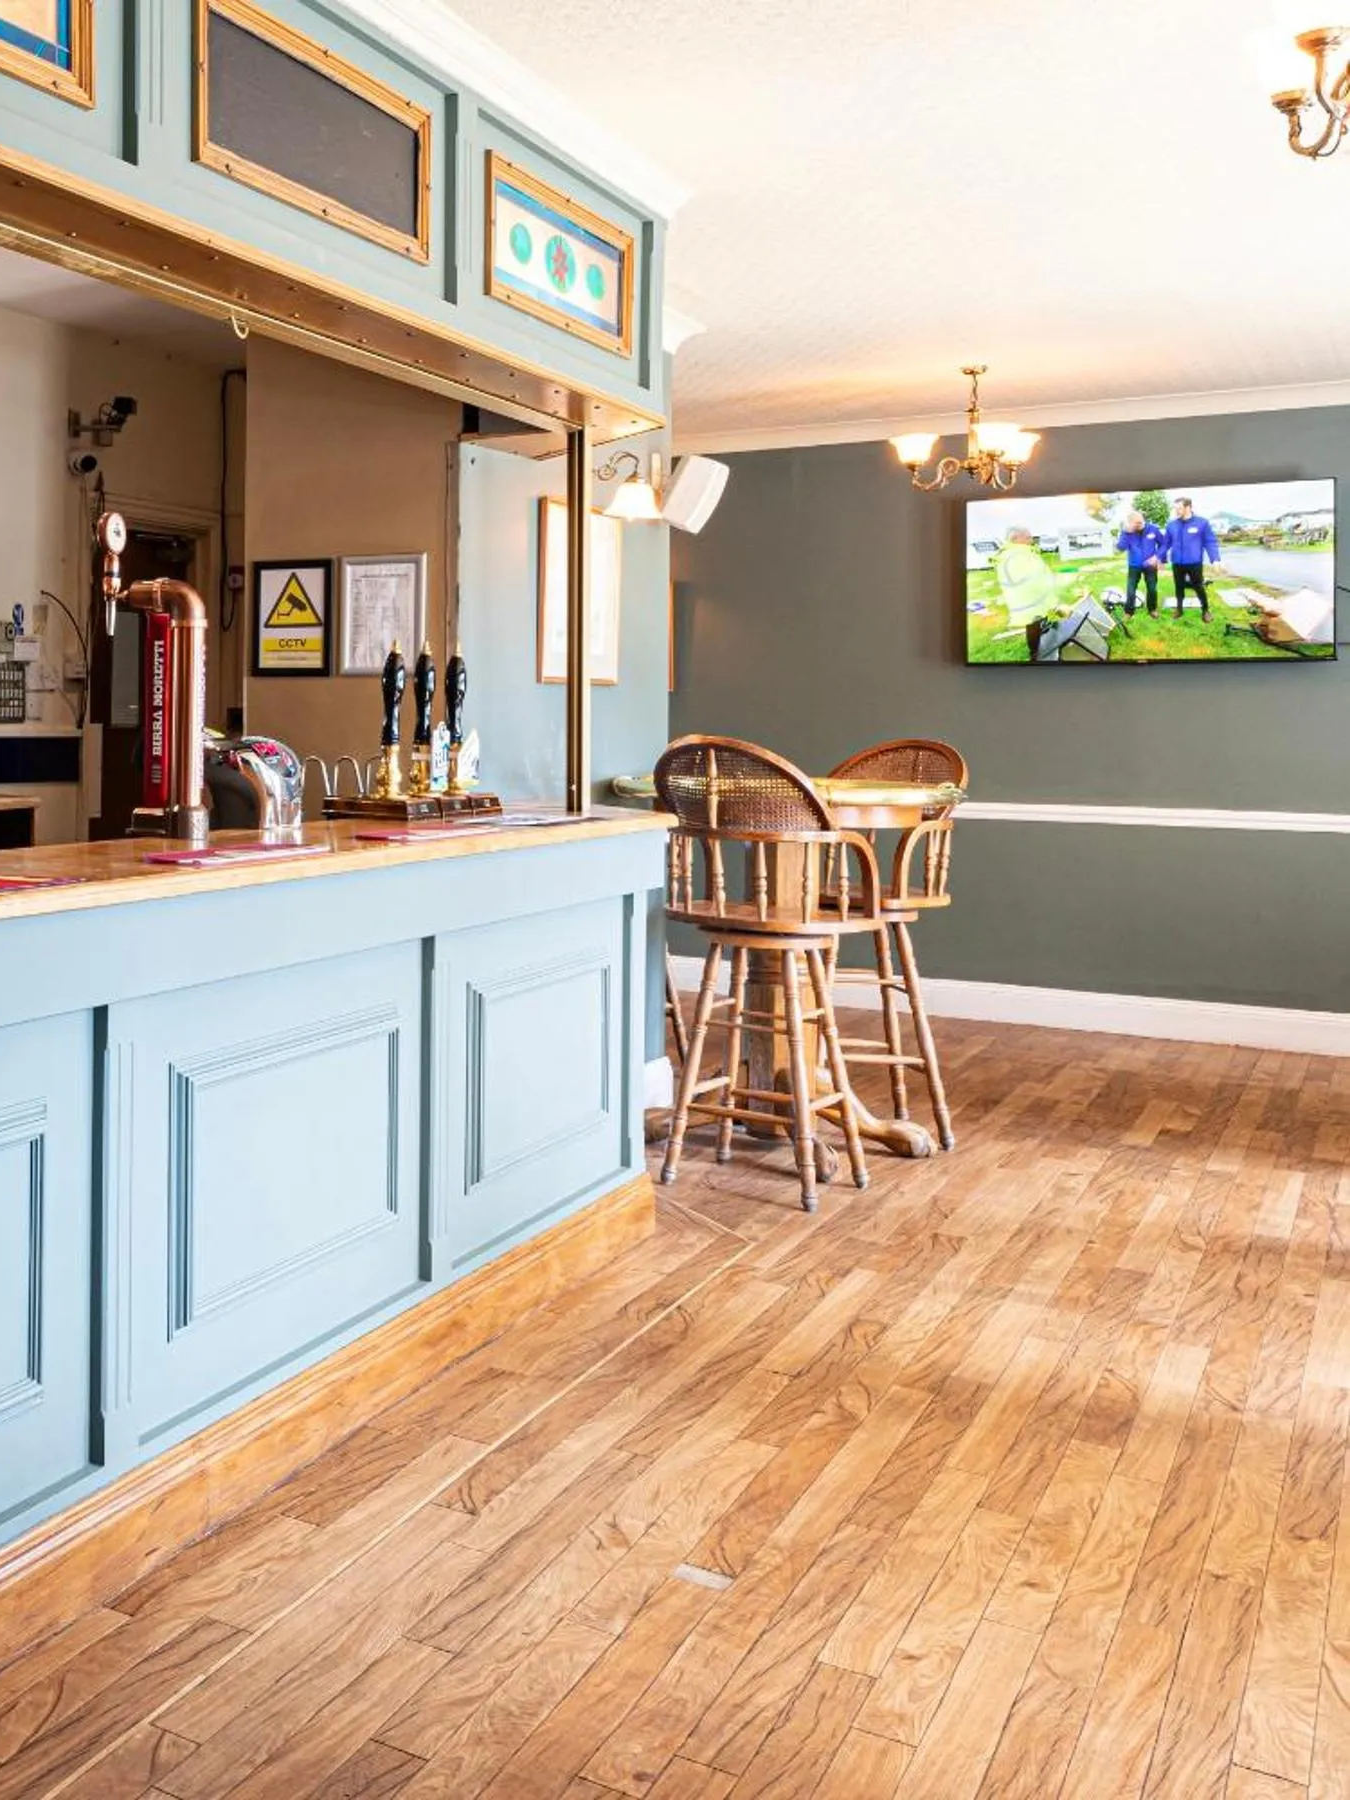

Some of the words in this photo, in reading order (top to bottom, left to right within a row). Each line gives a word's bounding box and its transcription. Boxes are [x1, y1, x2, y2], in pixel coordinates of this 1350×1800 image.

[278, 638, 308, 649] CCTV
[152, 640, 165, 707] MORETTI
[152, 710, 163, 757] BIRRA
